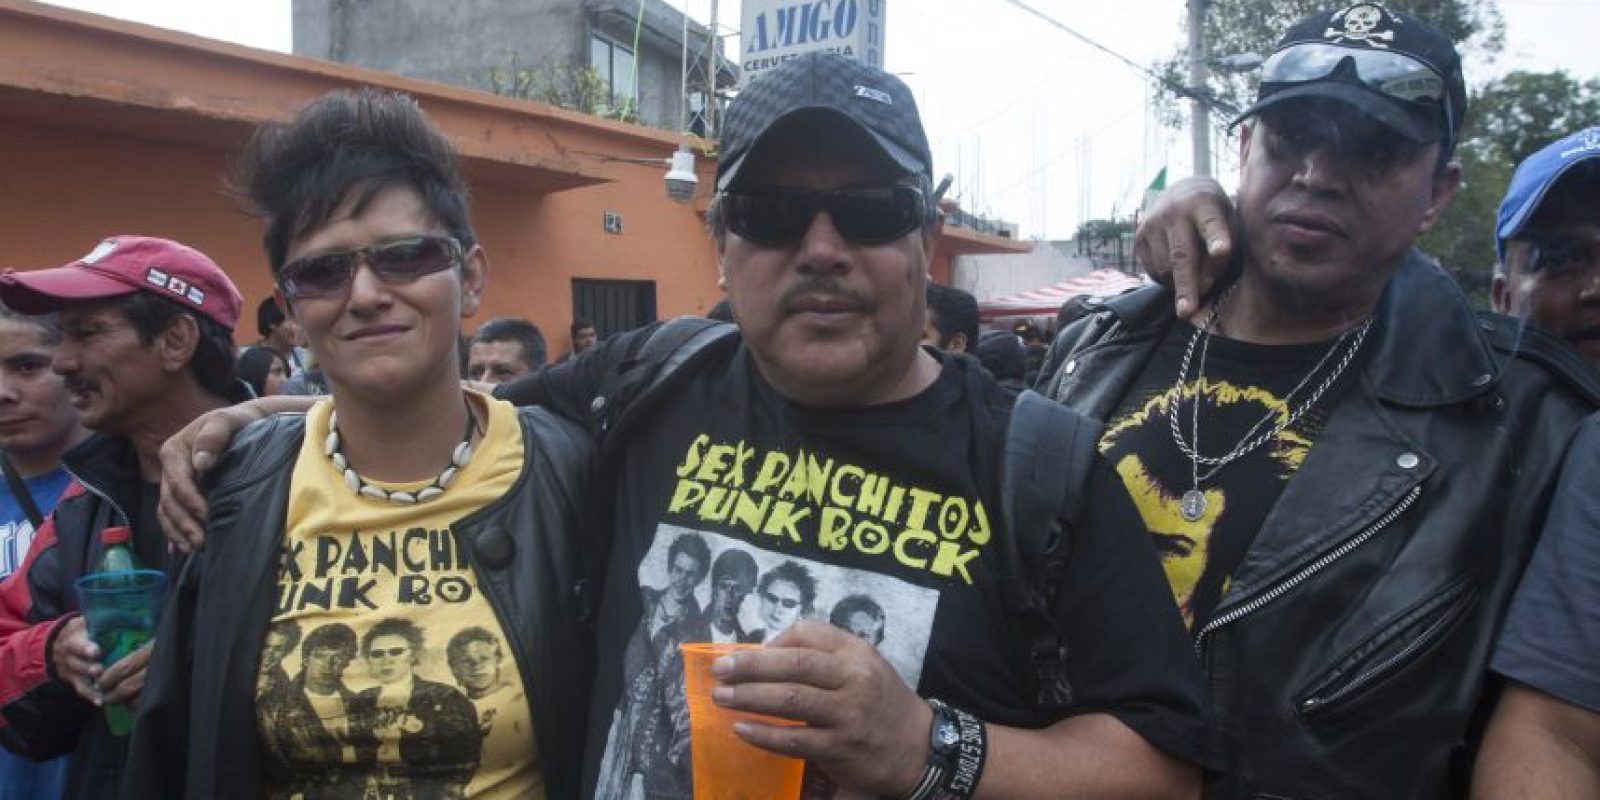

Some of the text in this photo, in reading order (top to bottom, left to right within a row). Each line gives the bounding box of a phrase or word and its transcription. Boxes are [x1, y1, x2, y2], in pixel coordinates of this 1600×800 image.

[747, 0, 857, 53] AMIGO
[676, 433, 991, 546] SEX PANCHITOS
[315, 528, 470, 578] PANCHI
[667, 479, 980, 583] PUNK ROCK
[275, 576, 473, 611] UNK RO
